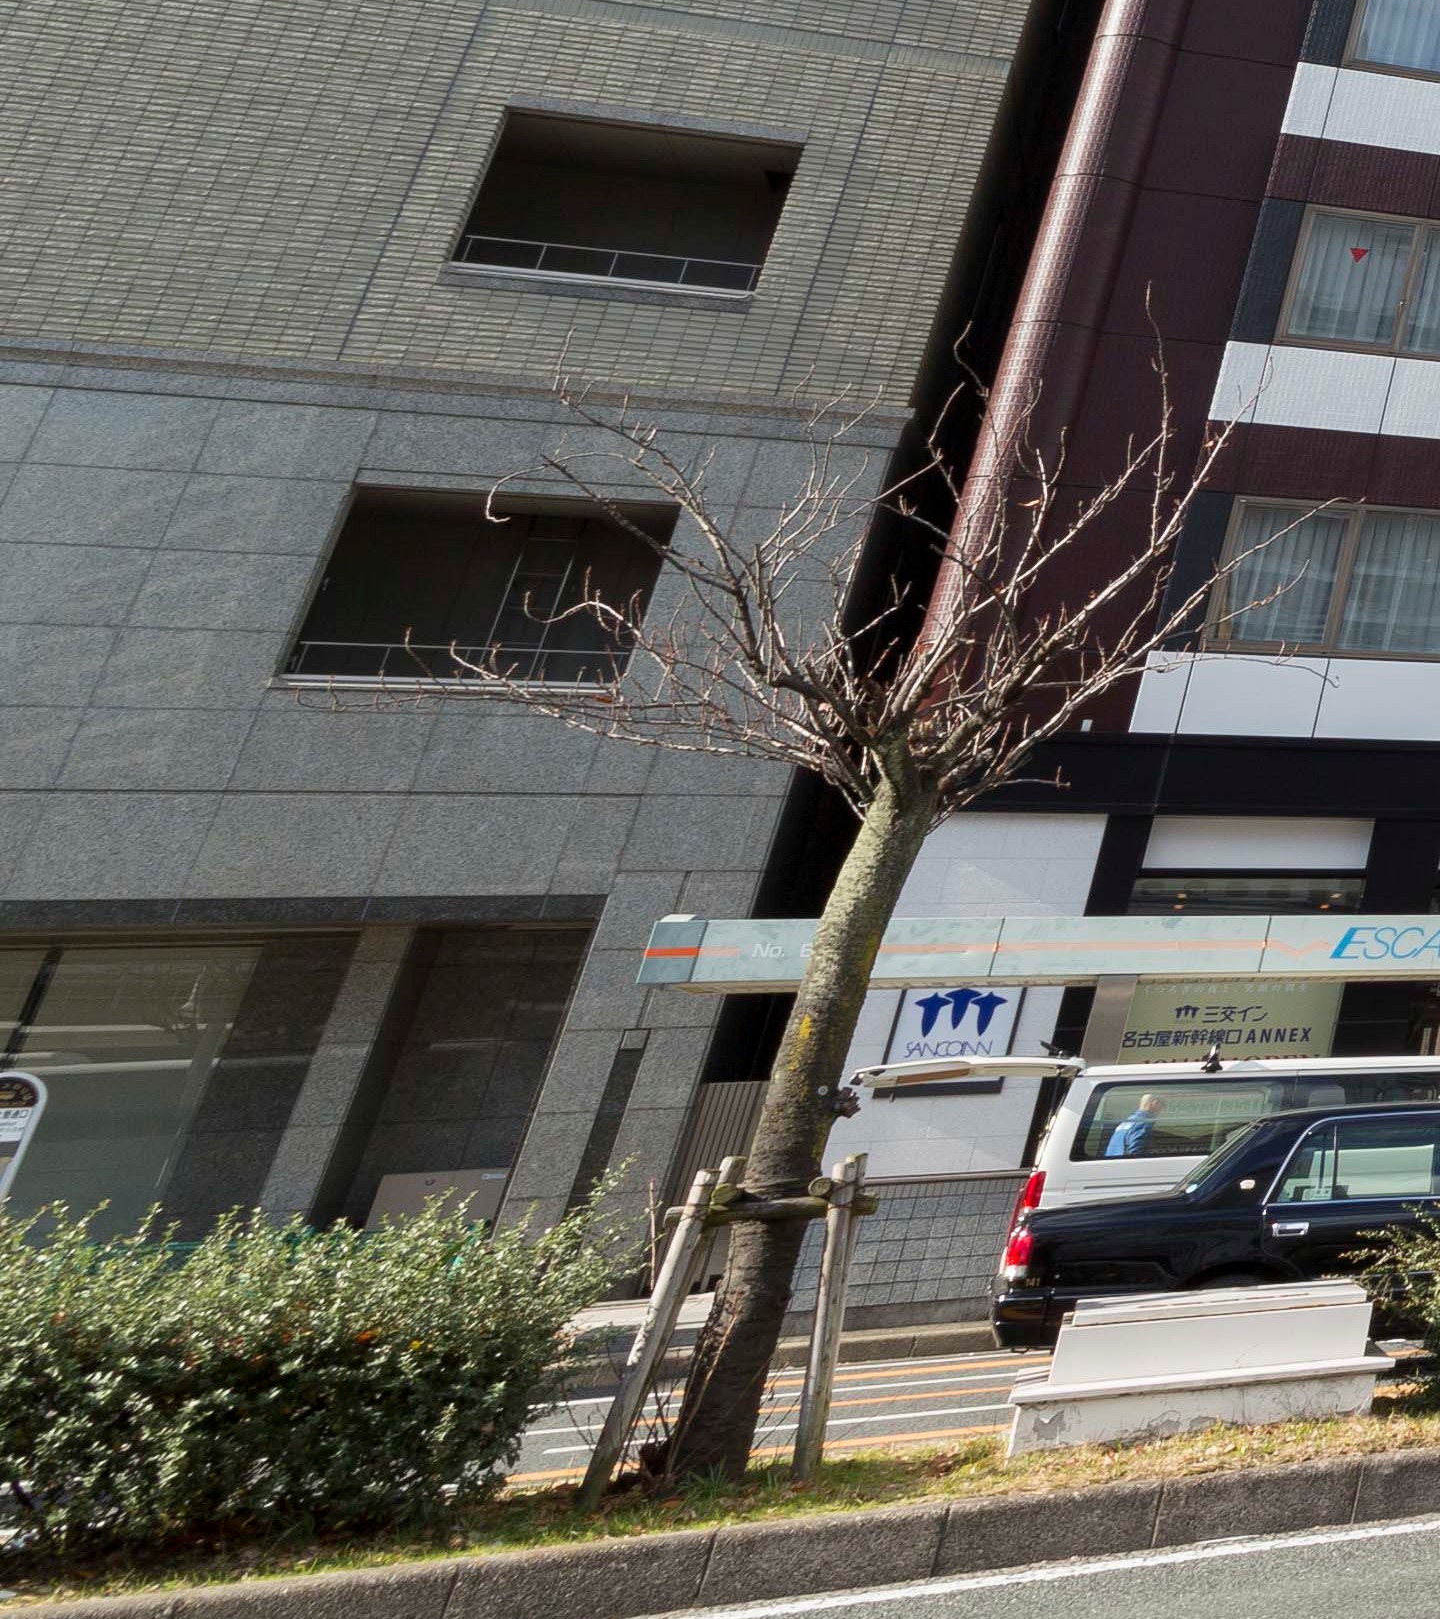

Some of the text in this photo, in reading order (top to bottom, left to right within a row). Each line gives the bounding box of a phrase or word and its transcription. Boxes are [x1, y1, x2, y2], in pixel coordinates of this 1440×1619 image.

[751, 942, 784, 958] No.
[1202, 1004, 1270, 1024] 三交イン
[1122, 1026, 1313, 1049] 名古屋新幹線口 ANNEX
